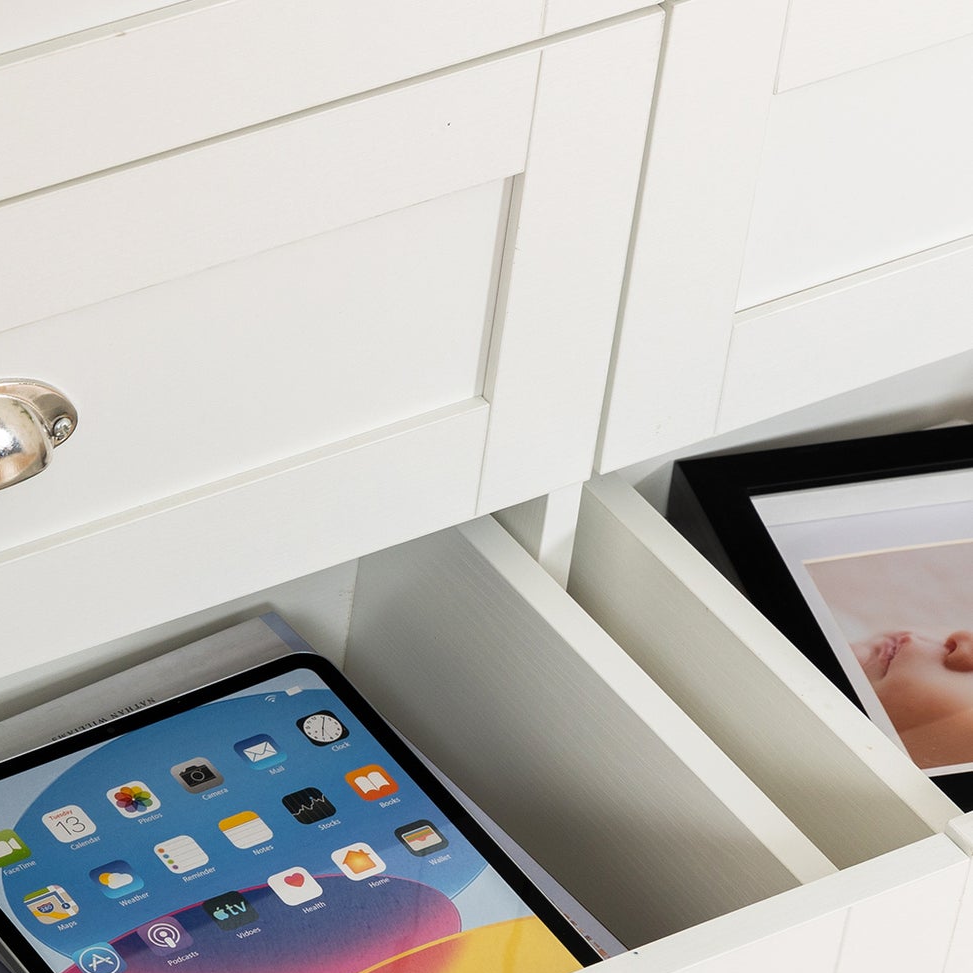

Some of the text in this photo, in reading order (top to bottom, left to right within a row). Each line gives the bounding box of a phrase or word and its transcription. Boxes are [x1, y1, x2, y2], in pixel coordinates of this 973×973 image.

[110, 697, 156, 718] NATHAN
[331, 741, 351, 752] Clock
[268, 765, 285, 777] Mail
[201, 787, 229, 802] Camera
[379, 796, 402, 809] Books
[48, 809, 74, 822] Tuesday
[137, 812, 163, 825] Photos
[55, 816, 86, 836] 13
[317, 818, 341, 832] Stocks
[70, 836, 101, 851] Calendar
[252, 844, 275, 857] Notes
[428, 853, 452, 867] Wallet
[2, 860, 36, 877] FaceTime
[182, 866, 216, 884] Reminder
[368, 876, 390, 889] Home
[118, 890, 150, 908] Weather
[302, 900, 327, 915] Health
[57, 919, 77, 932] Maps
[236, 926, 262, 940] Vidoes
[167, 950, 199, 967] Podcasts
